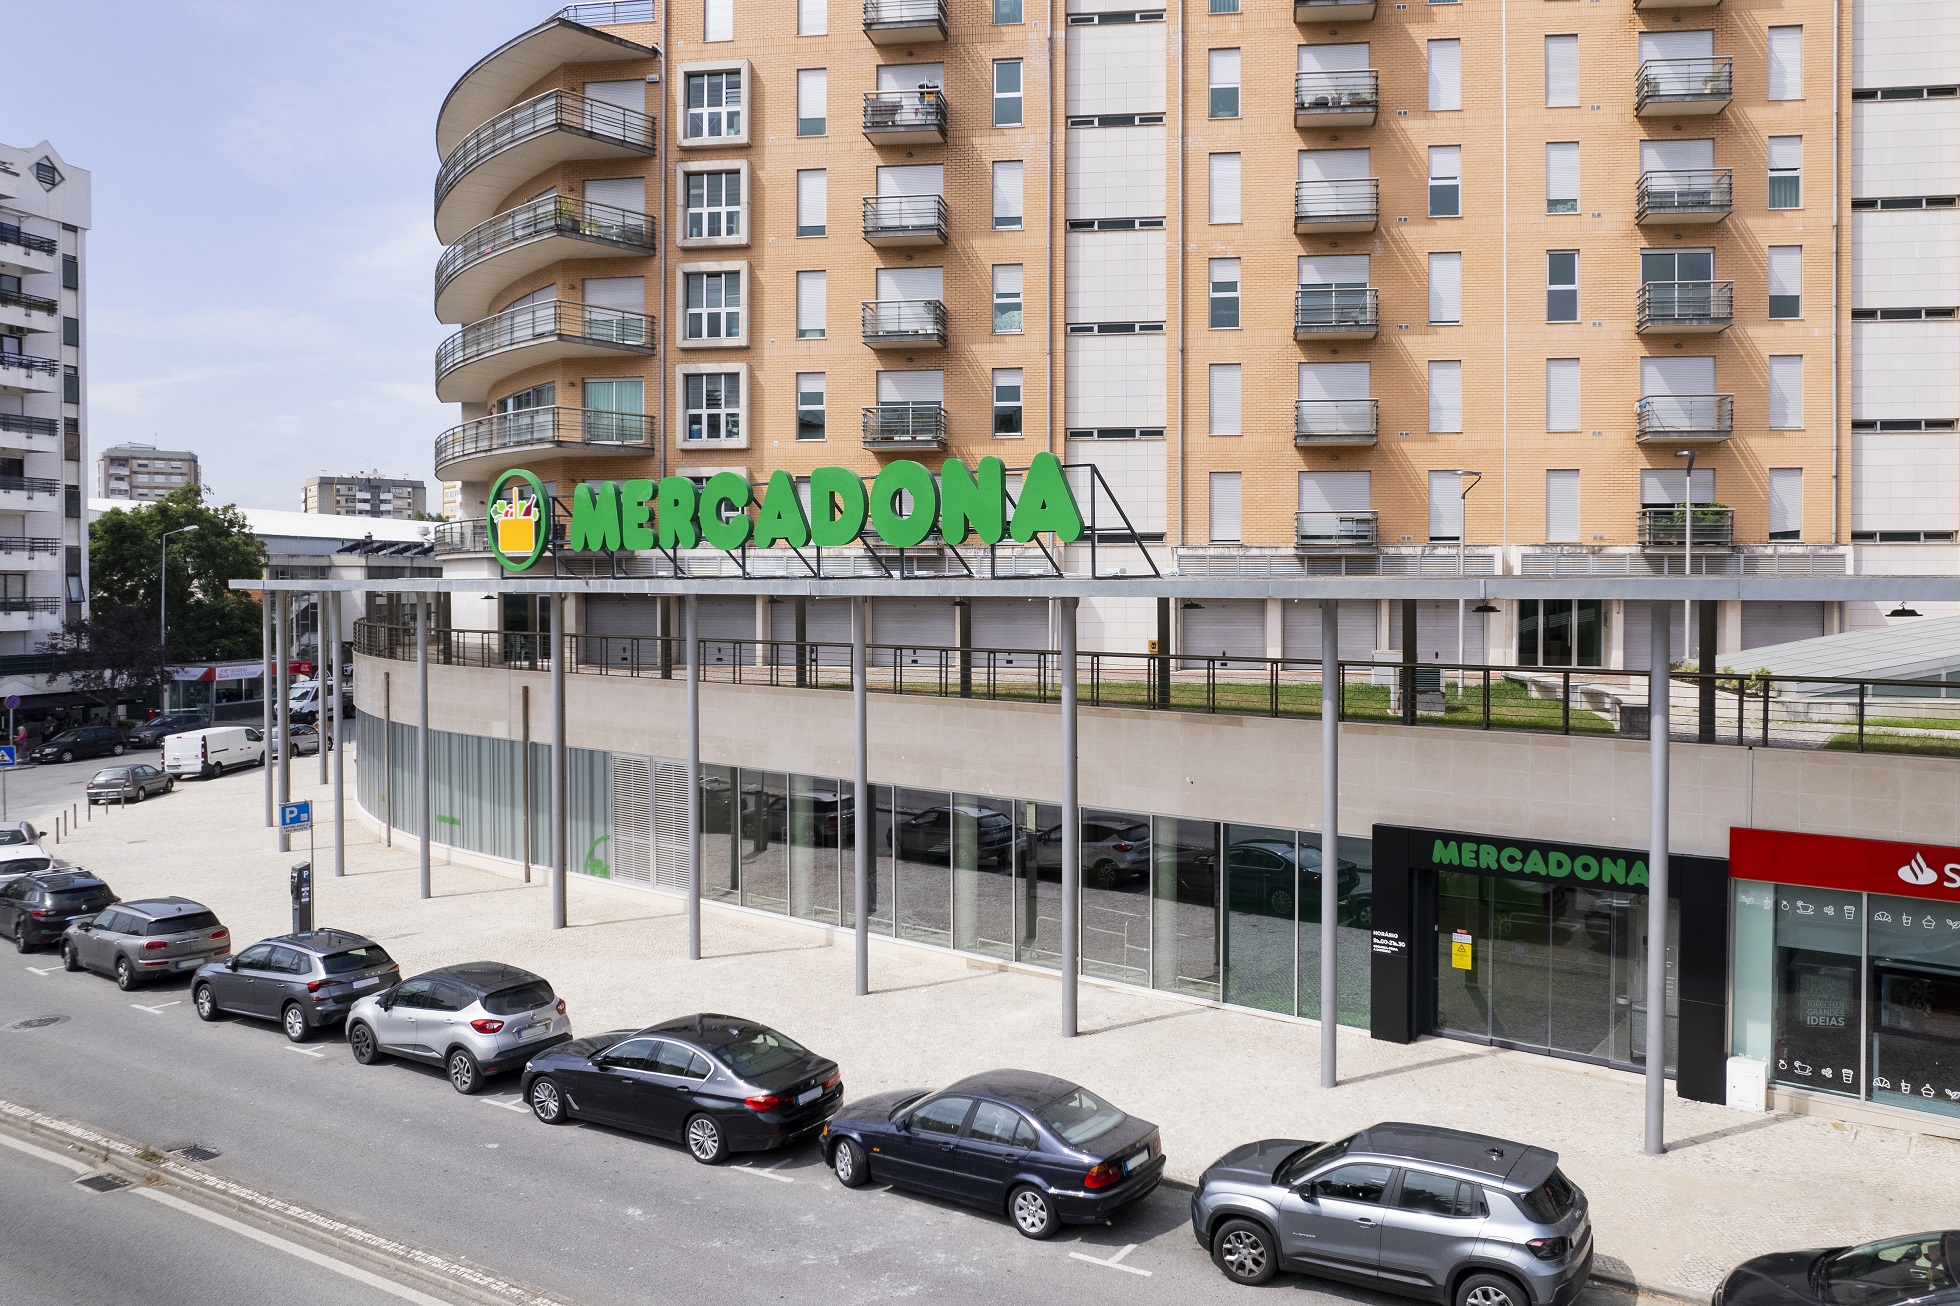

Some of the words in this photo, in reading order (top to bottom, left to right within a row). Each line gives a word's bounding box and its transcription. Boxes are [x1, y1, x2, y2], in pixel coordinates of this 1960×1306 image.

[570, 452, 1085, 552] MERCADONA
[286, 807, 298, 823] P
[1432, 839, 1650, 888] MERCADONA
[303, 870, 309, 878] P
[1373, 930, 1398, 938] HORÁRIO
[1807, 1016, 1845, 1026] IDEIAS
